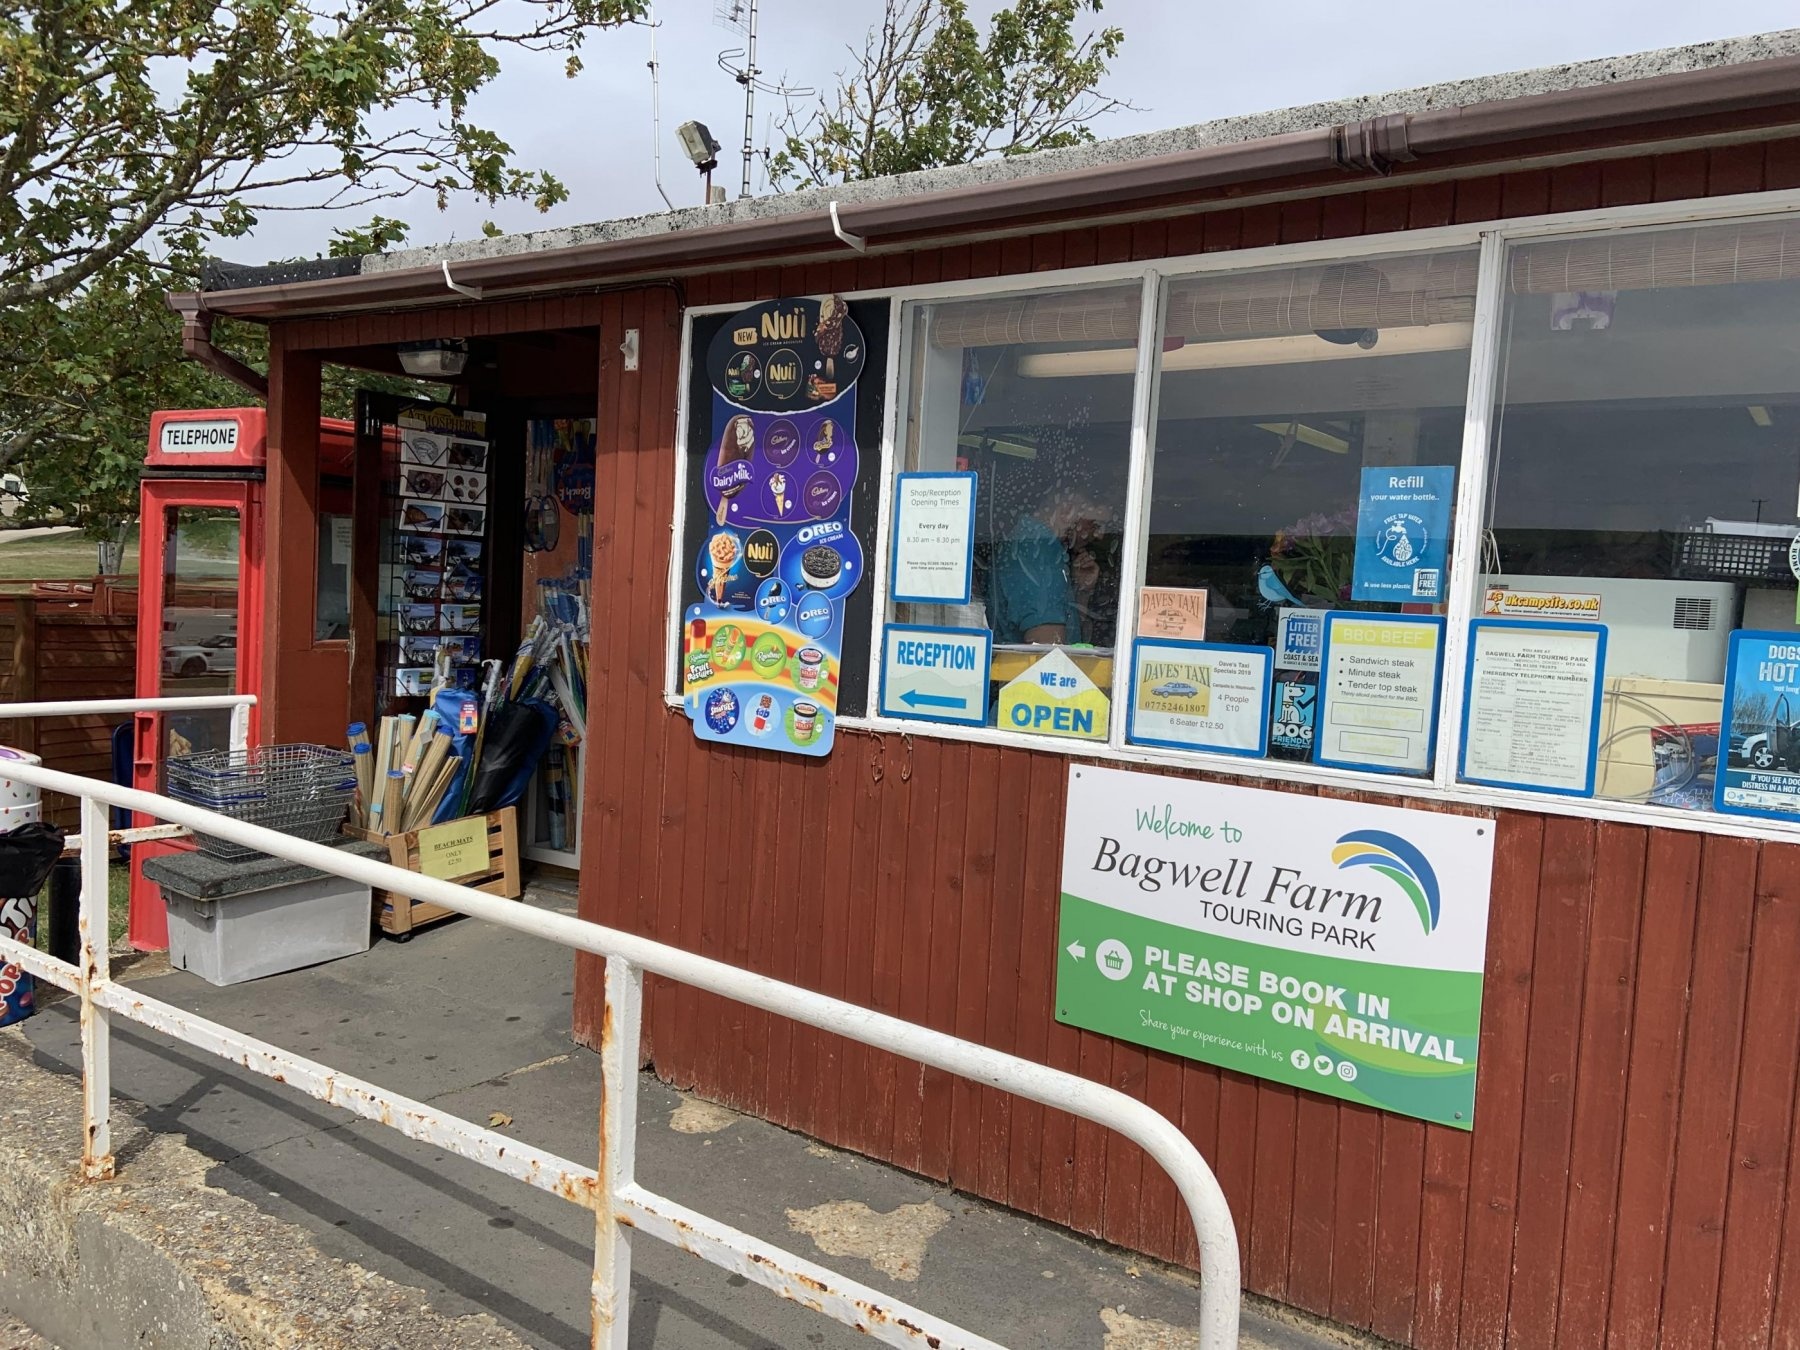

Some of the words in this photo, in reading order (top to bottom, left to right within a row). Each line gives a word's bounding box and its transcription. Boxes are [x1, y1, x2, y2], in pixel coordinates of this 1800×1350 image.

[761, 307, 806, 340] Nuii
[737, 331, 753, 342] NEW
[769, 362, 797, 381] Nuii
[167, 428, 236, 445] TELEPHONE
[713, 475, 734, 487] Dairy
[1389, 476, 1424, 488] Refill
[910, 489, 962, 497] Shop/Reception
[911, 499, 938, 507] Opening
[798, 522, 842, 543] OREO
[827, 533, 844, 542] CREAM
[748, 543, 774, 560] Nuii
[1418, 580, 1436, 588] FREE
[760, 596, 786, 607] OREO
[1142, 593, 1176, 615] DAVES'
[1177, 594, 1200, 619] TAXI
[1504, 594, 1598, 611] ukcampsite.co.uk
[800, 608, 829, 620] OREO
[1290, 622, 1318, 632] LITTER
[1288, 632, 1318, 647] FREE
[1381, 630, 1424, 644] BEEF
[896, 640, 976, 670] RECEPTION
[1349, 656, 1389, 666] Sandwich
[690, 662, 710, 672] Fruit
[1348, 668, 1376, 677] Minute
[1759, 662, 1799, 683] HOT
[1040, 672, 1056, 686] WE
[1059, 676, 1077, 688] are
[1184, 665, 1210, 688] TAXI
[1348, 680, 1376, 690] Tender
[1379, 684, 1392, 692] top
[1224, 695, 1249, 703] People
[756, 708, 770, 718] fab
[1145, 702, 1206, 713] 07752461807
[1011, 703, 1093, 733] OPEN
[1176, 719, 1198, 727] Seater
[1200, 721, 1224, 729] £12.50
[1272, 722, 1312, 739] DOG
[1272, 736, 1312, 745] FRIENDLY
[1742, 781, 1768, 790] DISTRESS
[1782, 785, 1796, 793] HOT
[1136, 804, 1214, 842] Welcome
[1220, 820, 1243, 844] to
[434, 841, 455, 851] BEACH
[456, 836, 473, 846] MATS
[1091, 836, 1252, 898] Bagwell
[1260, 866, 1382, 923] Farm
[1200, 900, 1304, 936] TOURING
[1311, 922, 1376, 952] PARK
[1144, 945, 1249, 989] PLEASE
[1258, 972, 1348, 1012] BOOK
[1357, 992, 1390, 1020] IN
[1142, 970, 1178, 996] AT
[1185, 981, 1262, 1016] SHOP
[1271, 1001, 1314, 1030] ON
[1324, 1013, 1464, 1064] ARRIVAL
[1138, 1010, 1168, 1032] Share
[1169, 1024, 1192, 1040] your
[1192, 1029, 1244, 1052] experience
[1244, 1038, 1268, 1058] with
[1270, 1048, 1284, 1062] us
